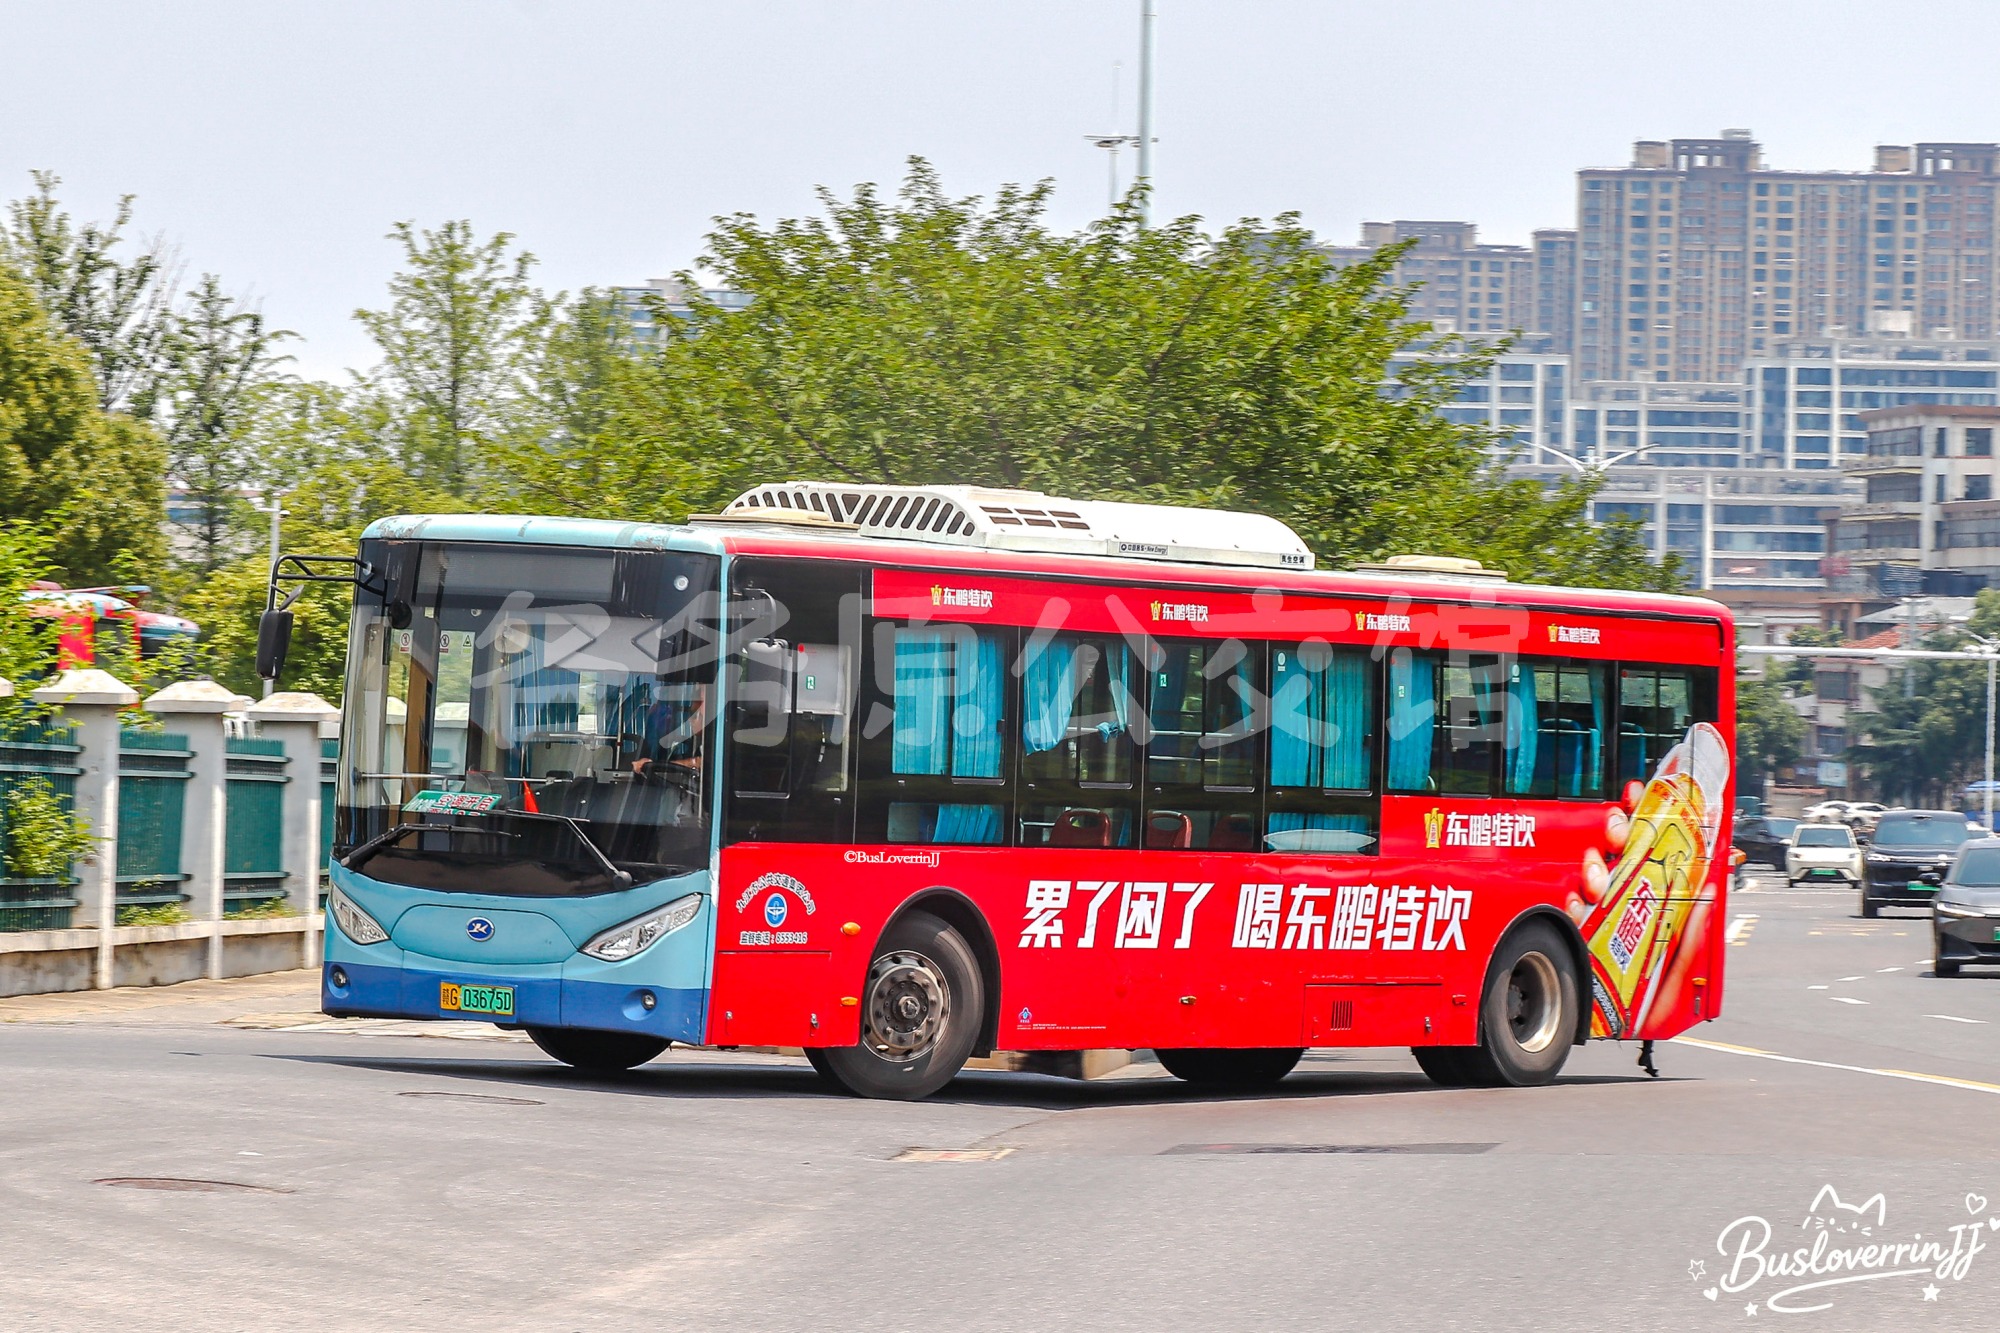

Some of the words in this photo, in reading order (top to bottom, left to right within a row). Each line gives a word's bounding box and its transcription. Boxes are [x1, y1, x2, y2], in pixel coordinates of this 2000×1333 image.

[943, 587, 993, 608] 东鹏特饮
[1162, 602, 1209, 622] 东鹏特饮
[1366, 613, 1411, 632] 东鹏特饮
[1557, 625, 1601, 645] 东鹏特饮
[1446, 811, 1536, 847] 东鹏特饮
[1018, 879, 1216, 949] 累了困了
[1231, 883, 1473, 951] 喝东鹏特饮
